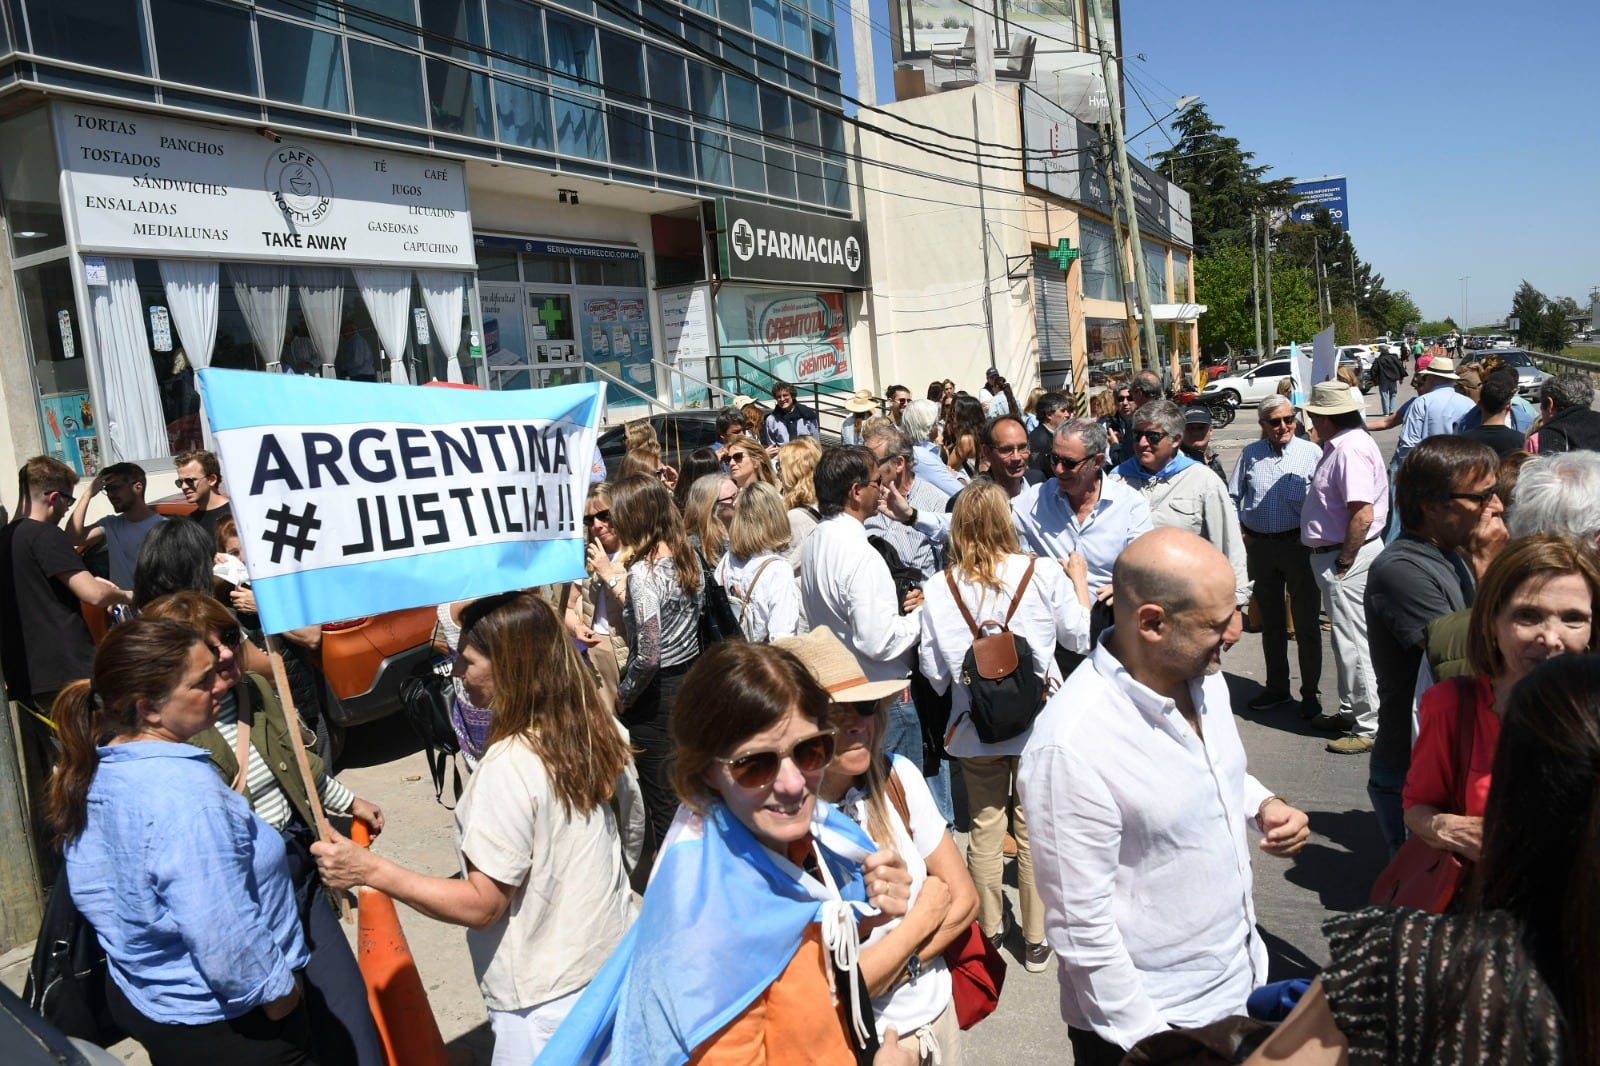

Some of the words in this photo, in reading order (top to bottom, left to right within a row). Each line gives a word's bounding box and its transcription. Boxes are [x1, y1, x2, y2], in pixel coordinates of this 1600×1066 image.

[74, 114, 137, 135] TORTAS
[160, 136, 225, 156] PANCHOS
[80, 146, 161, 168] TOSTADOS
[278, 150, 315, 168] CAFE
[373, 160, 388, 172] TÉ
[424, 168, 448, 181] CAFÉ
[132, 173, 228, 196] SÁNDWICHES
[392, 183, 423, 196] JUGOS
[85, 195, 177, 215] ENSALADAS
[272, 191, 310, 222] NORTH
[312, 195, 331, 220] SIDE
[408, 205, 455, 218] LICUADOS
[133, 223, 229, 241] MEDIALUNAS
[368, 221, 419, 235] GASEOSAS
[262, 232, 303, 249] TAKE
[306, 234, 347, 251] AWAY
[403, 241, 459, 254] CAPUCHINO
[756, 228, 844, 265] FARMACIA
[249, 424, 573, 496] ARGENTINA
[342, 485, 550, 556] JUSTICIA
